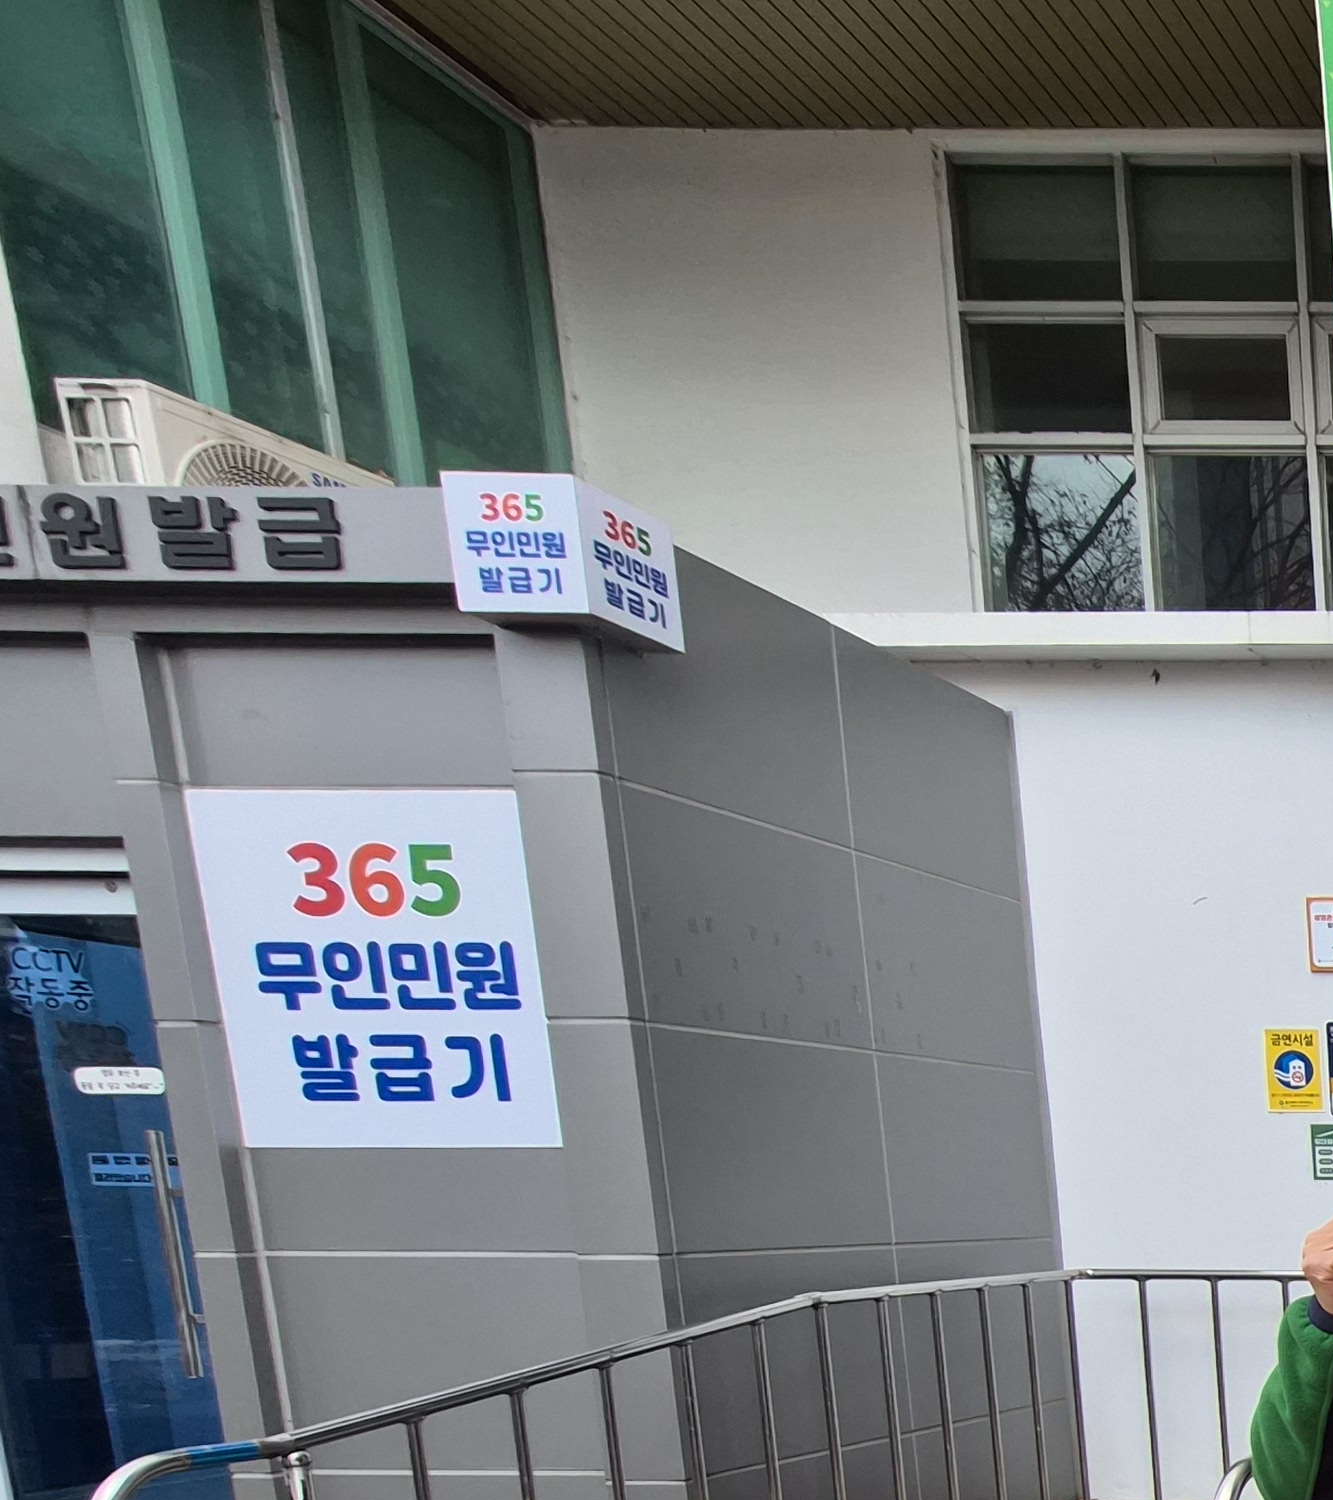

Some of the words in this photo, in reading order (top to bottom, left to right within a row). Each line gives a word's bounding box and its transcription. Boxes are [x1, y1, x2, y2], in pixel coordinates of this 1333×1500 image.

[479, 493, 544, 522] 365
[466, 531, 567, 559] 무인민원
[602, 510, 653, 557] 365
[479, 567, 563, 594] 발급기
[593, 539, 669, 599] 무인민원
[604, 577, 667, 629] 발급기
[285, 841, 463, 918] 365
[12, 947, 83, 974] CCTV
[254, 939, 523, 1012] 무인민원
[1270, 1033, 1314, 1047] 금연시설
[291, 1033, 513, 1102] 발급기
